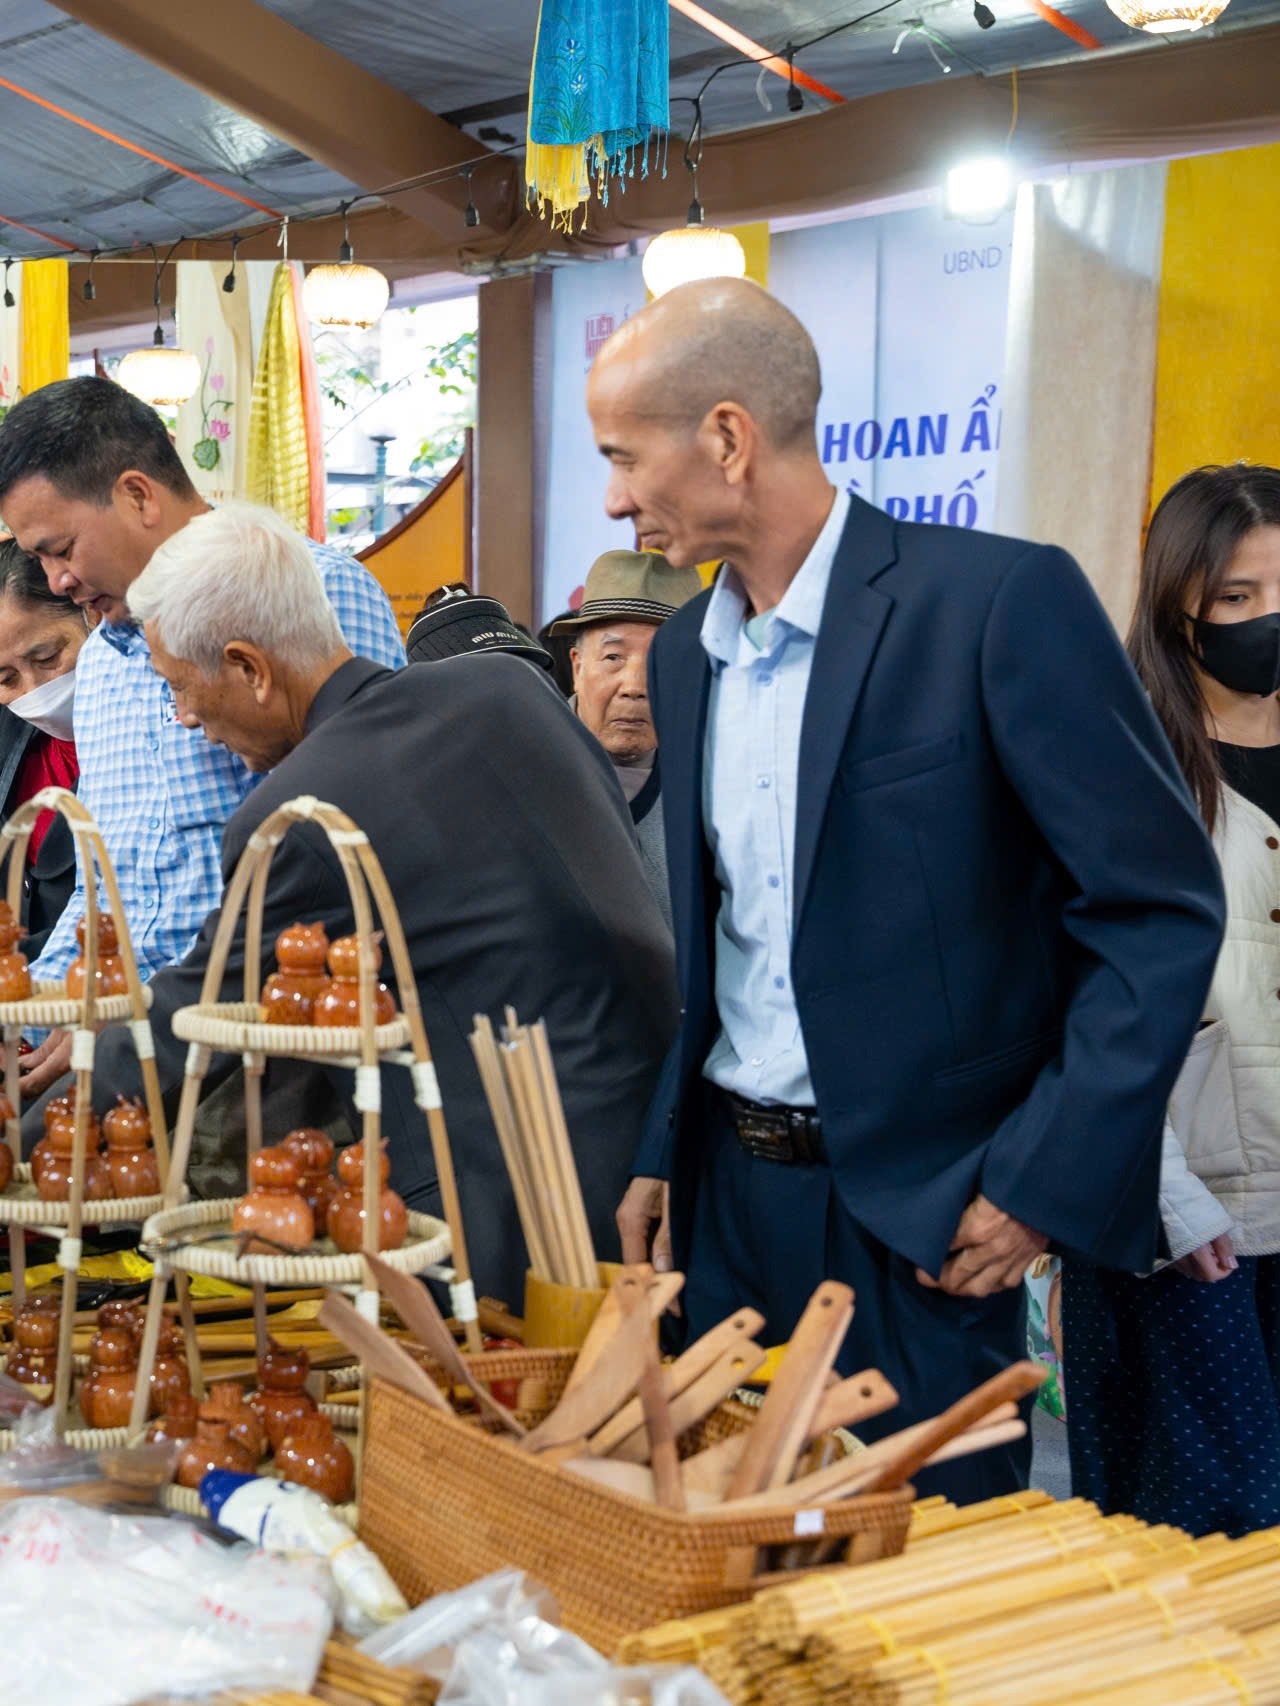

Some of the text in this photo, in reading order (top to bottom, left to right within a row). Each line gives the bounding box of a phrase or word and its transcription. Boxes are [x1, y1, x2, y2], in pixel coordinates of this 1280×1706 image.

[944, 247, 1002, 274] UBND
[823, 384, 1002, 464] HOAN Ẩ
[884, 469, 987, 530] PHỐ
